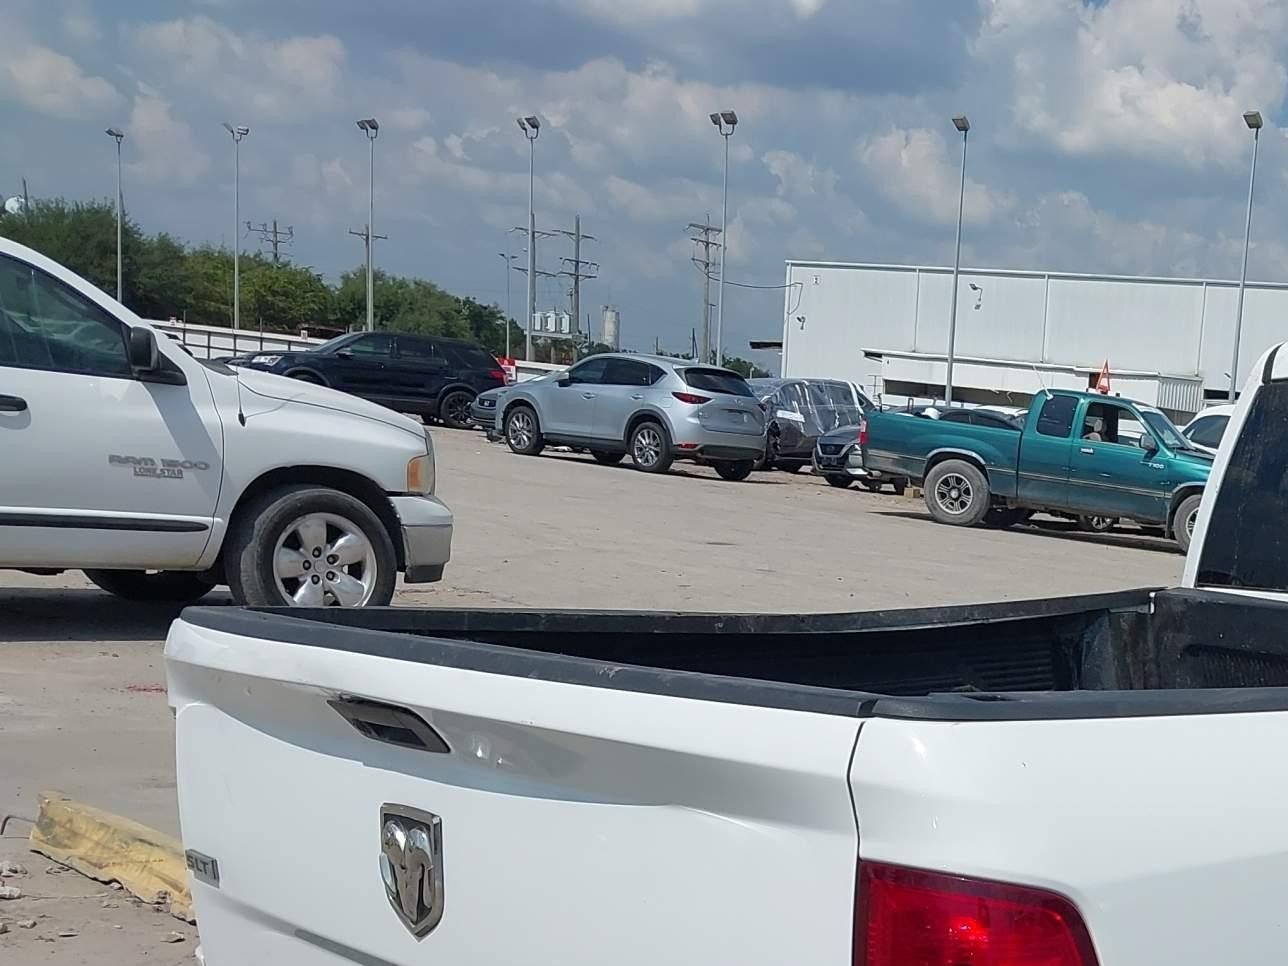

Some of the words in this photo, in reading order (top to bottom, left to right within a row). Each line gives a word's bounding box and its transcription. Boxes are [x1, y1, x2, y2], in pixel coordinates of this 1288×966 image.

[108, 454, 156, 466] RAM
[160, 458, 210, 470] 1500
[160, 468, 184, 478] STAR
